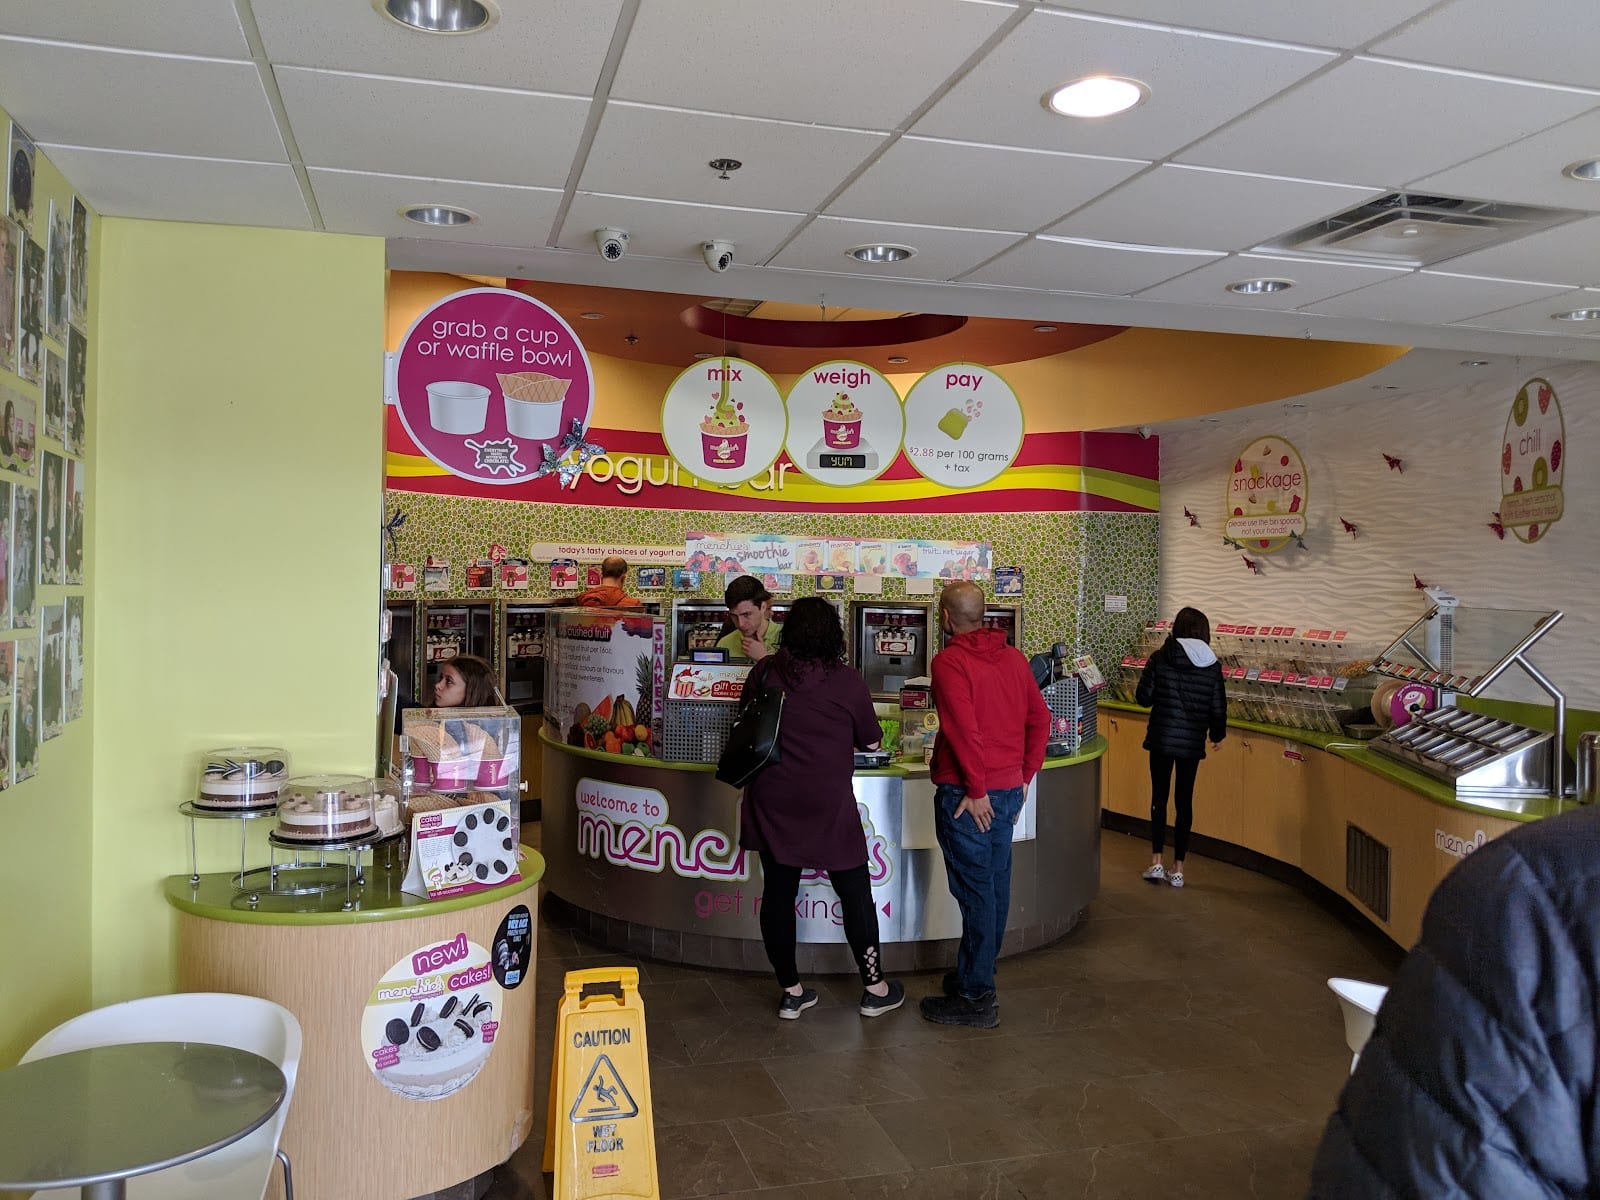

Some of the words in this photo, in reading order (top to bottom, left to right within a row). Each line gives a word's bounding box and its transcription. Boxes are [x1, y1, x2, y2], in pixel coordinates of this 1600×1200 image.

[432, 320, 486, 339] grab
[493, 326, 508, 340] a
[516, 328, 558, 348] cup
[417, 341, 440, 355] or
[446, 342, 514, 362] waffle
[521, 346, 572, 367] bowl
[707, 365, 742, 382] mix
[814, 368, 871, 389] weigh
[946, 373, 983, 390] pay
[1520, 428, 1540, 456] chill
[910, 447, 934, 457] $2.88
[936, 450, 954, 459] per
[958, 450, 974, 459] 100
[977, 453, 1008, 461] grams
[570, 455, 698, 494] yogur
[954, 464, 970, 472] tax
[1234, 472, 1301, 491] snackage
[558, 546, 586, 555] today's
[587, 547, 605, 556] tasty
[607, 547, 638, 555] choices
[649, 549, 674, 558] yogurt
[737, 541, 790, 561] smoothie
[594, 627, 610, 639] fruit
[602, 666, 624, 675] flavours
[654, 629, 664, 713] SHAKES
[713, 682, 728, 693] gift
[581, 792, 638, 813] welcome
[643, 800, 660, 817] to
[695, 891, 743, 918] get
[416, 938, 466, 970] new!
[450, 965, 491, 988] cakes!
[573, 1028, 630, 1048] CAUTION
[373, 1045, 398, 1057] cakes
[592, 1123, 617, 1138] WET
[586, 1138, 624, 1153] FLOOR
